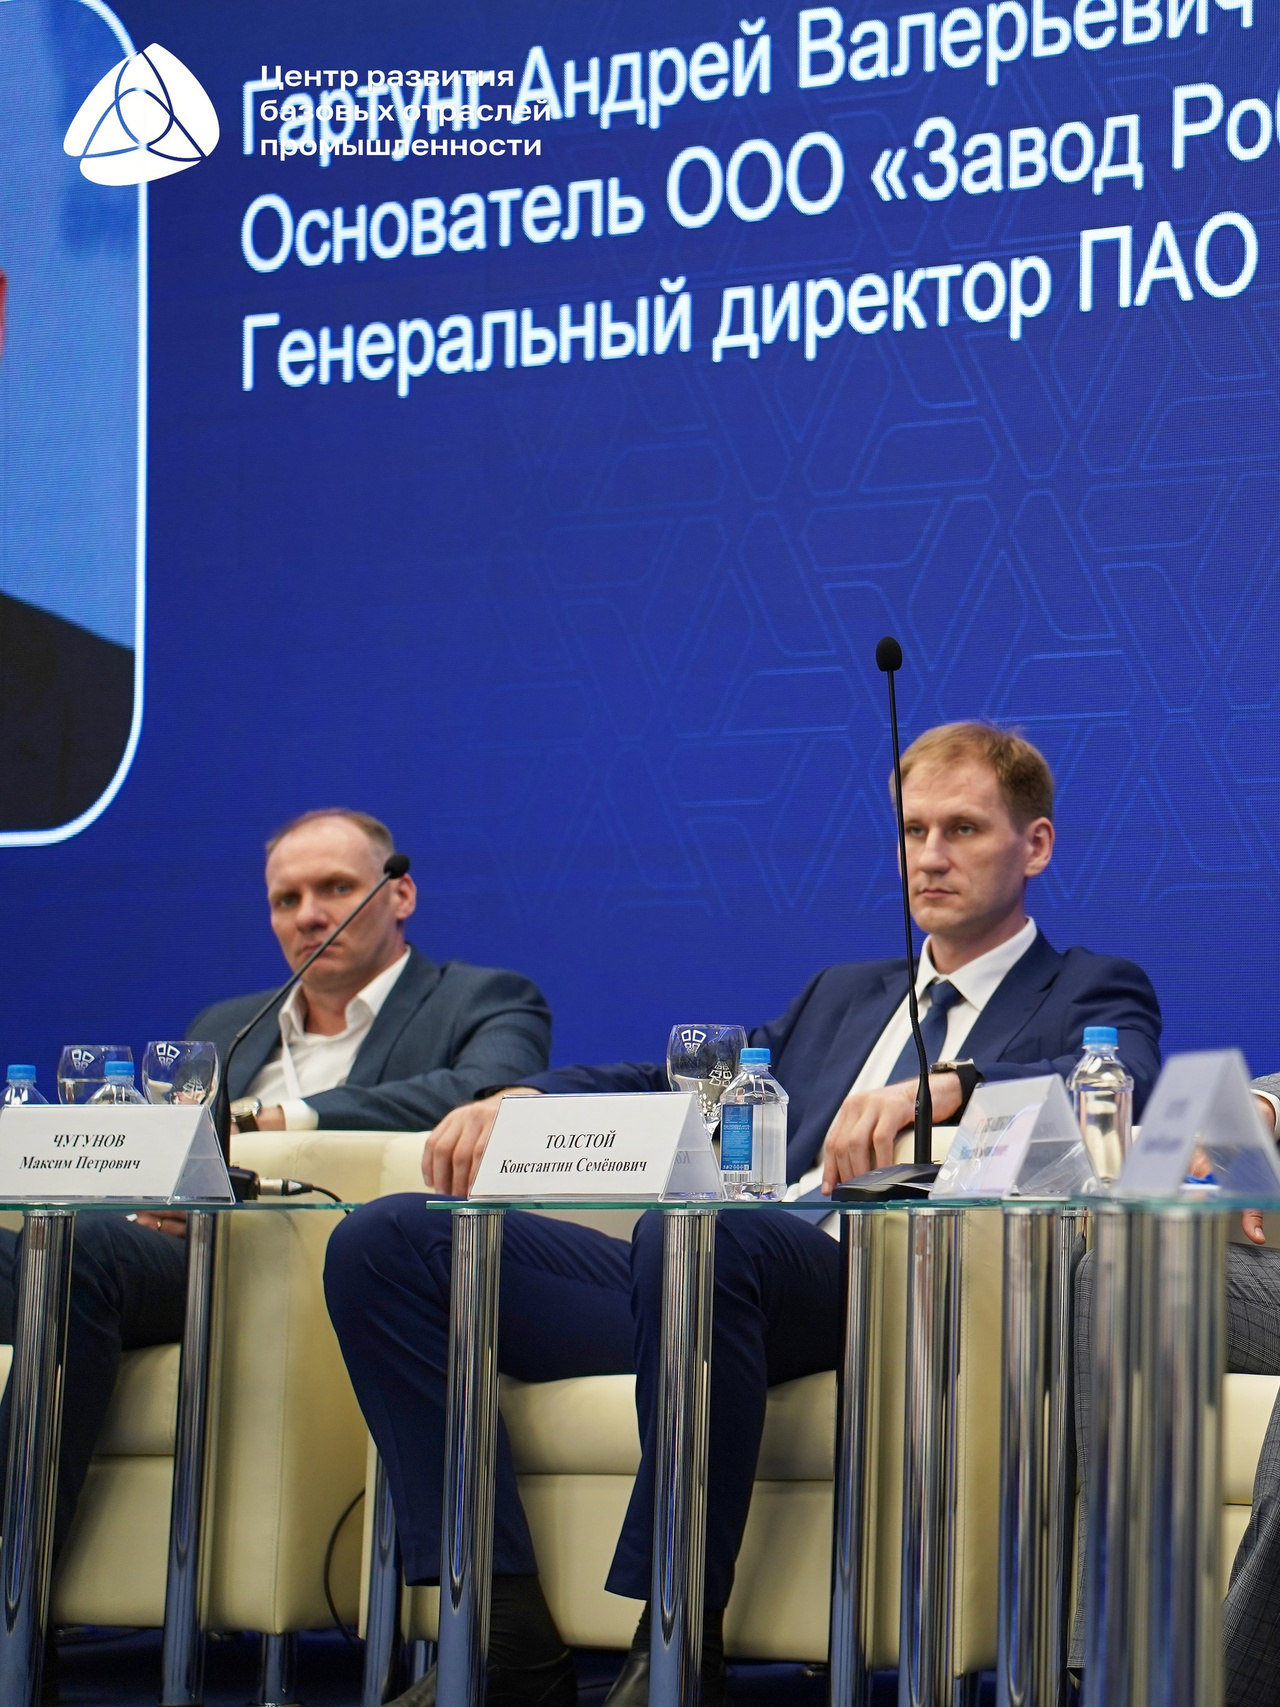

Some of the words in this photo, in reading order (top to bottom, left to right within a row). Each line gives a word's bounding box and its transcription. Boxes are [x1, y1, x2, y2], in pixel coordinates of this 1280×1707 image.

[511, 17, 772, 130] Андрей
[241, 177, 644, 273] Основатель
[666, 131, 845, 229] ООО
[870, 115, 1144, 201] «Завод
[241, 277, 692, 397] Генеральный
[711, 255, 1051, 362] директор
[1078, 210, 1259, 312] ПАО
[53, 1134, 126, 1148] ЧУГУНОВ
[546, 1129, 617, 1149] ТОЛСТОЙ
[19, 1156, 73, 1170] Максим
[75, 1155, 142, 1173] Петрович
[499, 1158, 574, 1174] Константин
[576, 1157, 648, 1173] Семёнович
